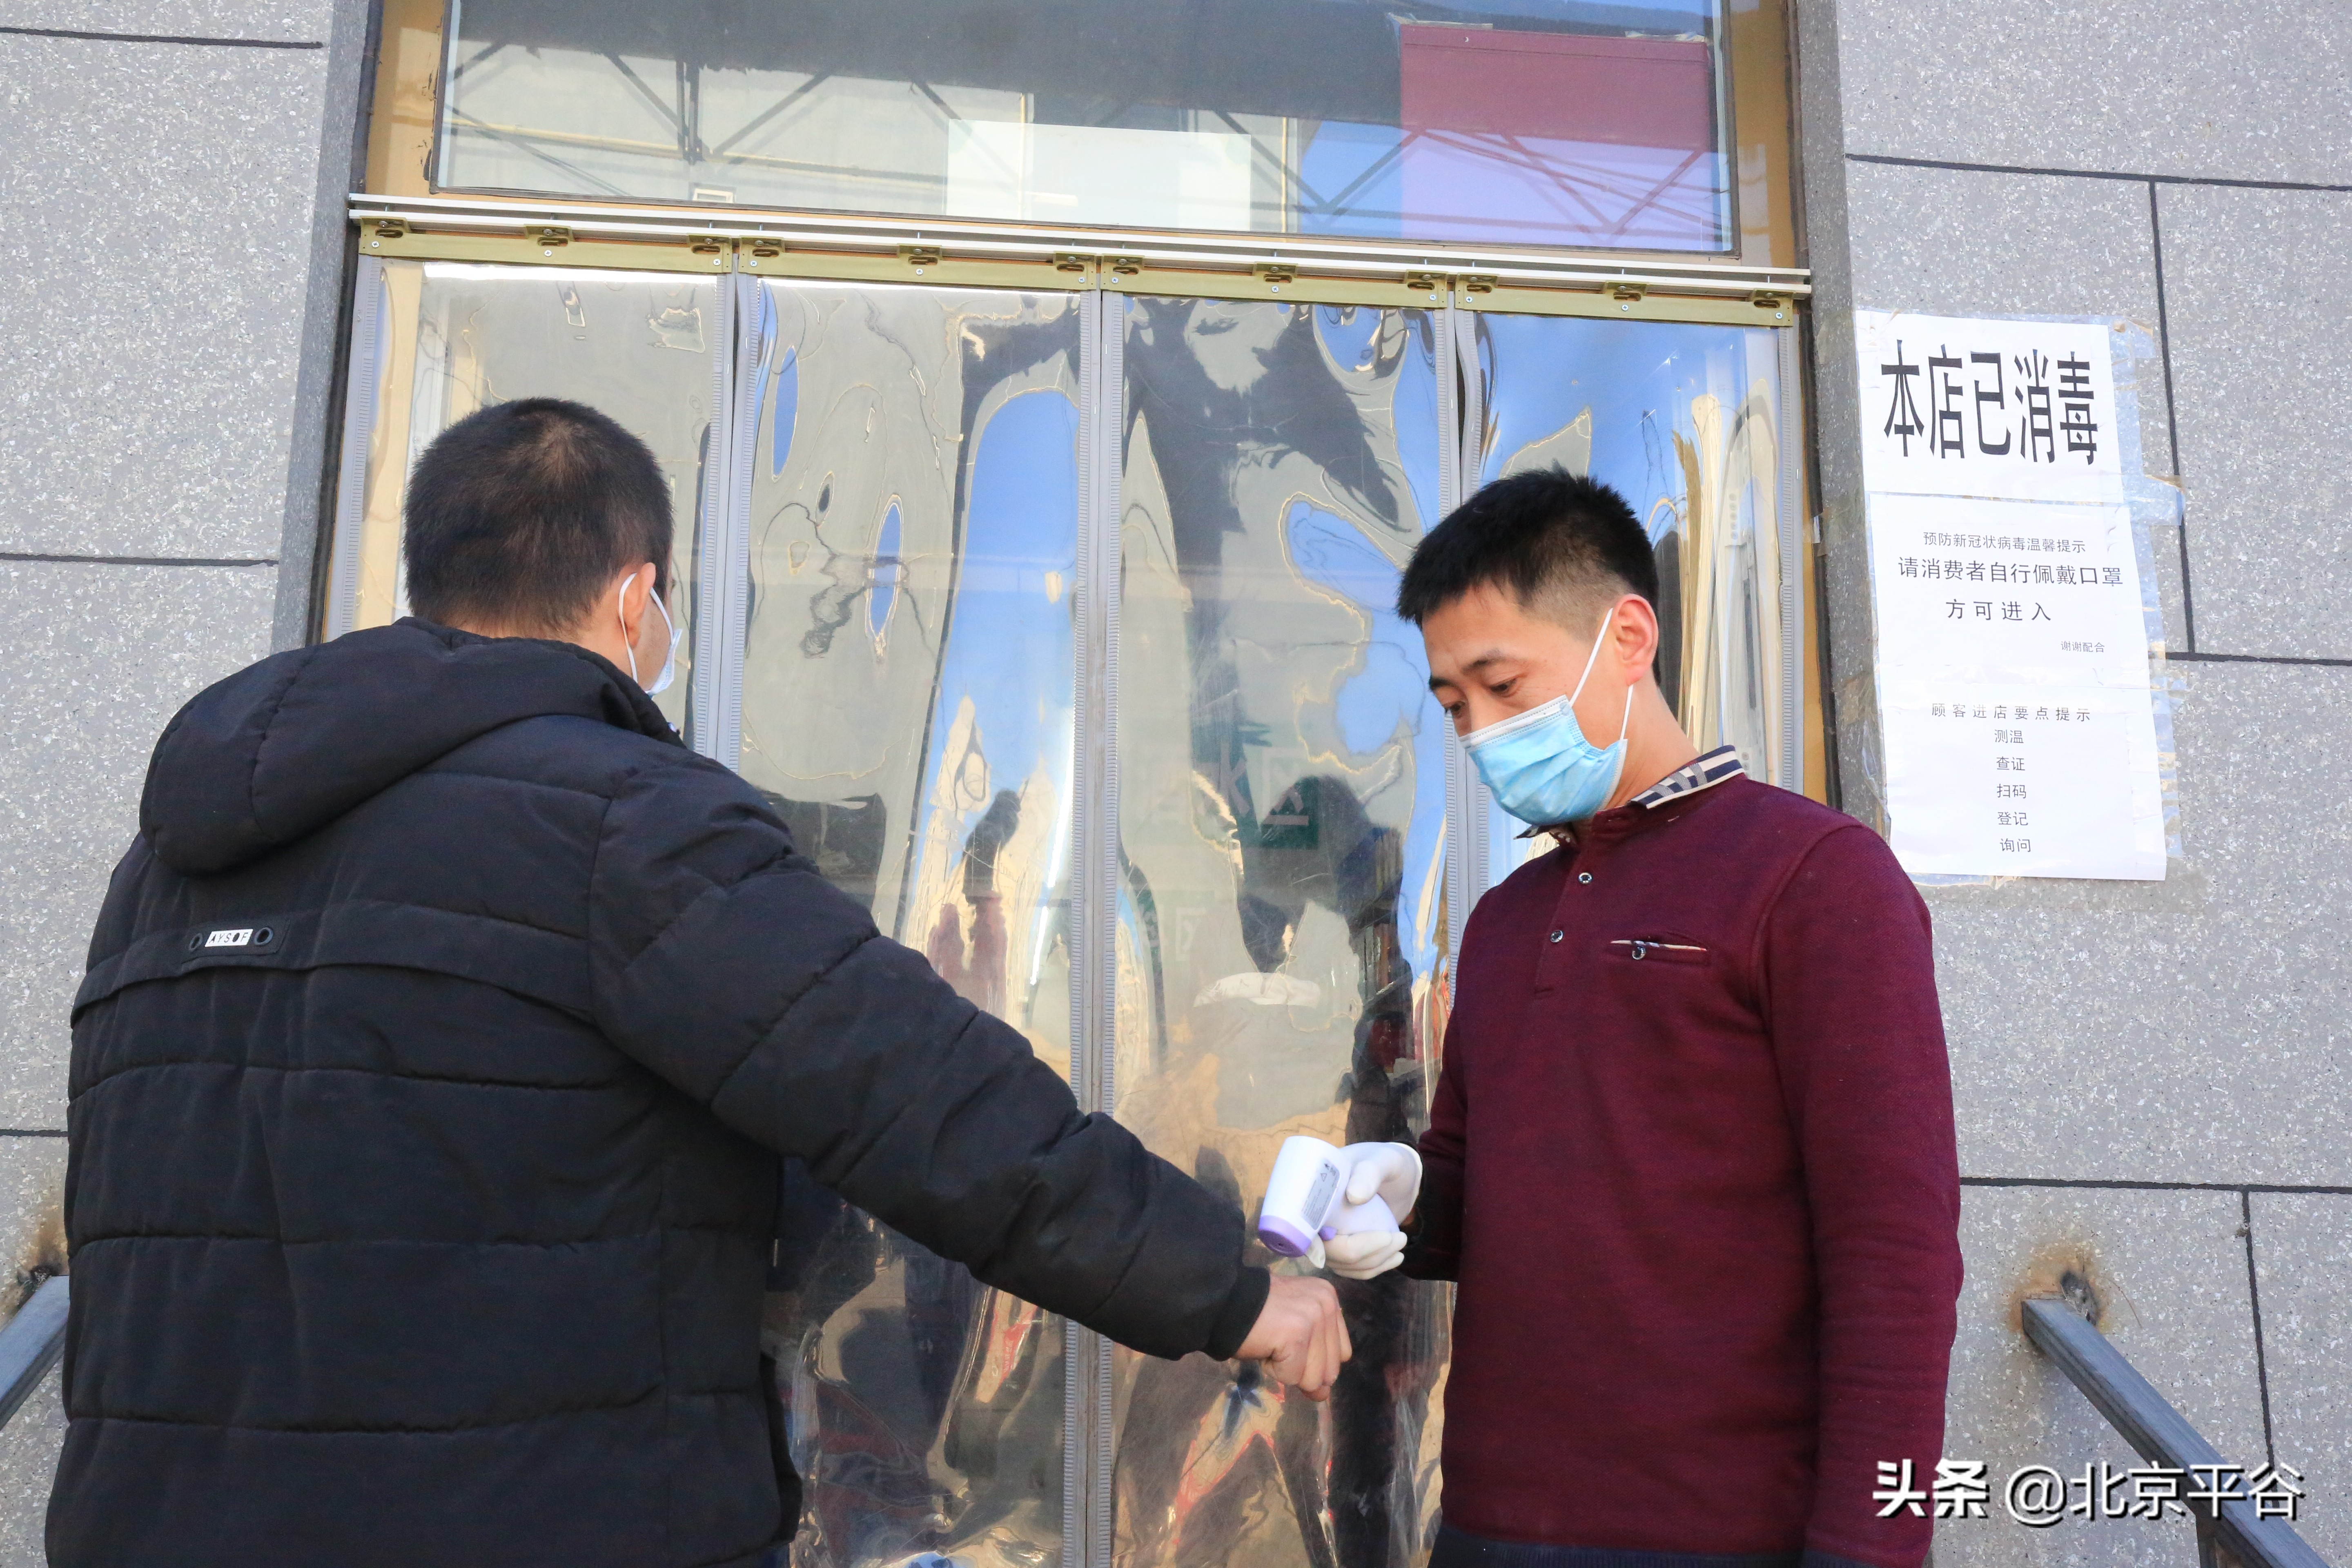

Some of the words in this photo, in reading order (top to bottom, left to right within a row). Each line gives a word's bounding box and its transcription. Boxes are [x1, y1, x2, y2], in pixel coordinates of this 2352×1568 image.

[1881, 339, 2098, 465] 本店已消毒
[1923, 532, 2086, 553] 预防新冠状病毒温馨提示
[1898, 557, 2123, 587] 请消费者自行佩戴口罩
[1945, 598, 2051, 621] 方可进入
[2060, 640, 2105, 653] 谢谢配合
[1932, 703, 2090, 722] 顾客进店要点提示
[1994, 729, 2024, 744] 测温
[1996, 756, 2025, 771] 查证
[1996, 783, 2027, 799] 扫码
[1997, 811, 2029, 826] 登记
[1999, 838, 2031, 853] 询问
